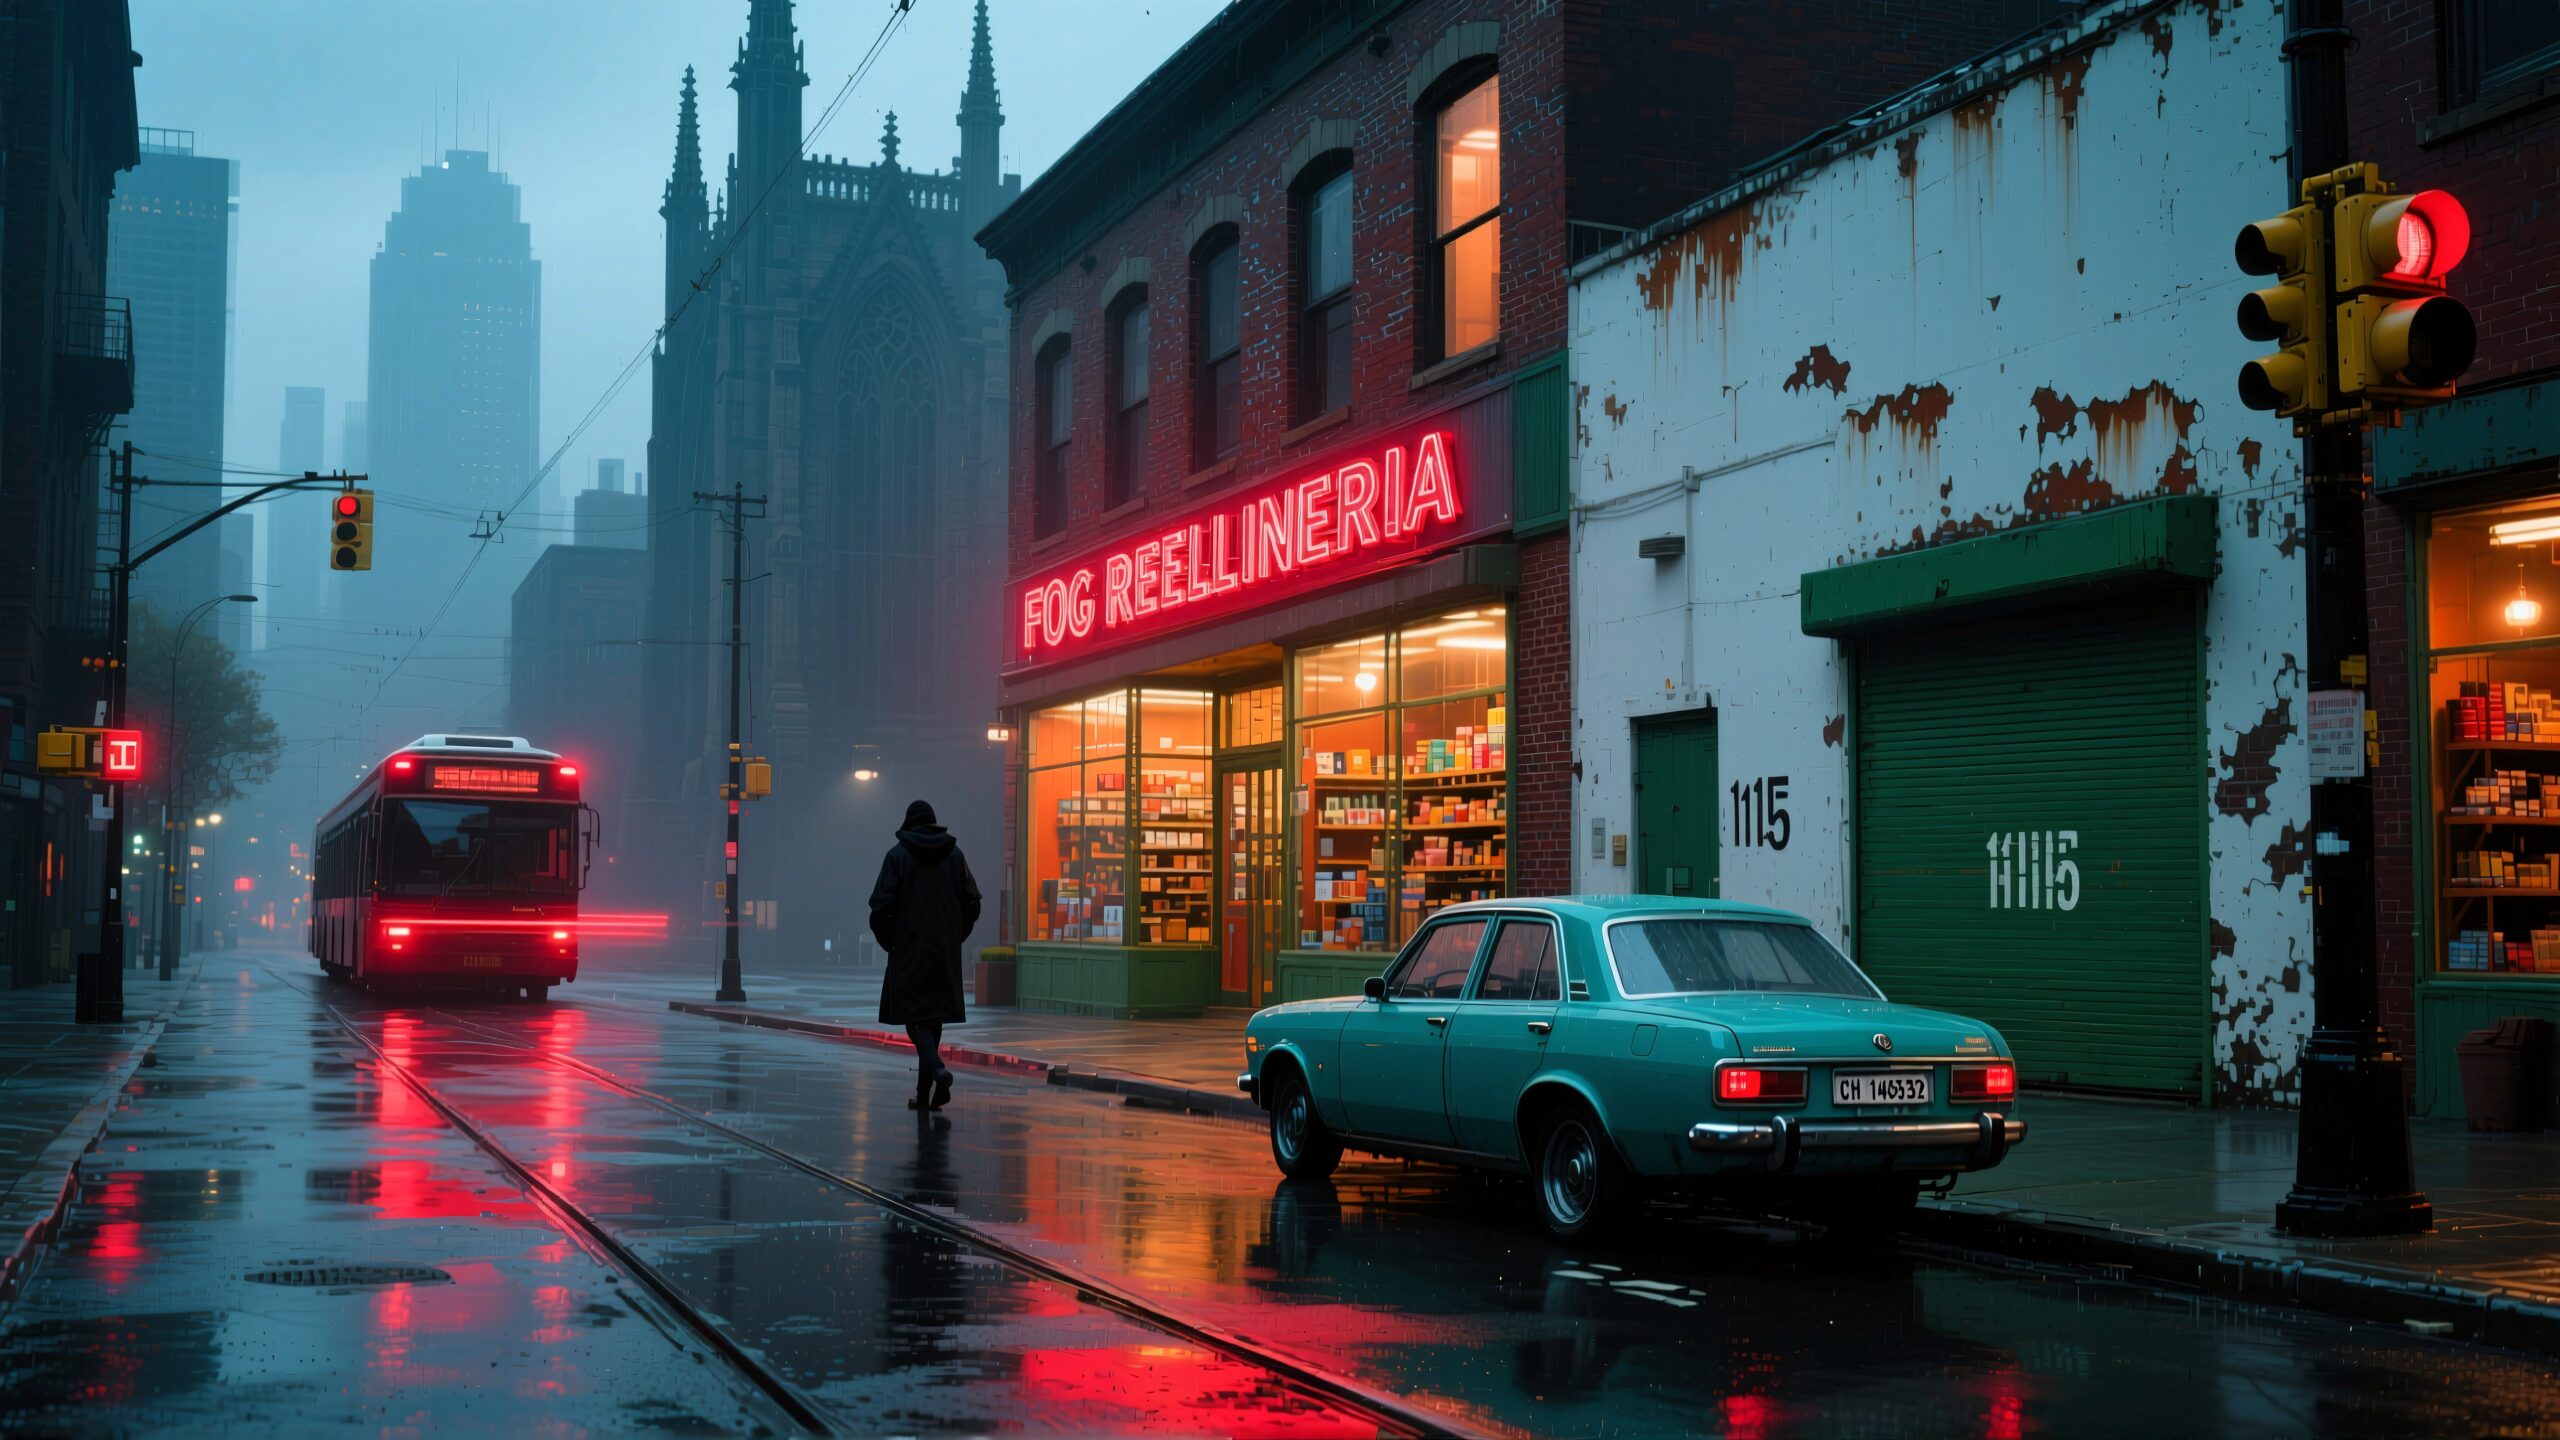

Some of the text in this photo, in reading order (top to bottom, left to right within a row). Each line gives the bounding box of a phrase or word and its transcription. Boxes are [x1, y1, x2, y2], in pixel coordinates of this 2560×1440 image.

[1023, 431, 1459, 649] FOG REELLINERIA
[1730, 776, 1790, 851] 1115
[1840, 1078, 1860, 1100] CH
